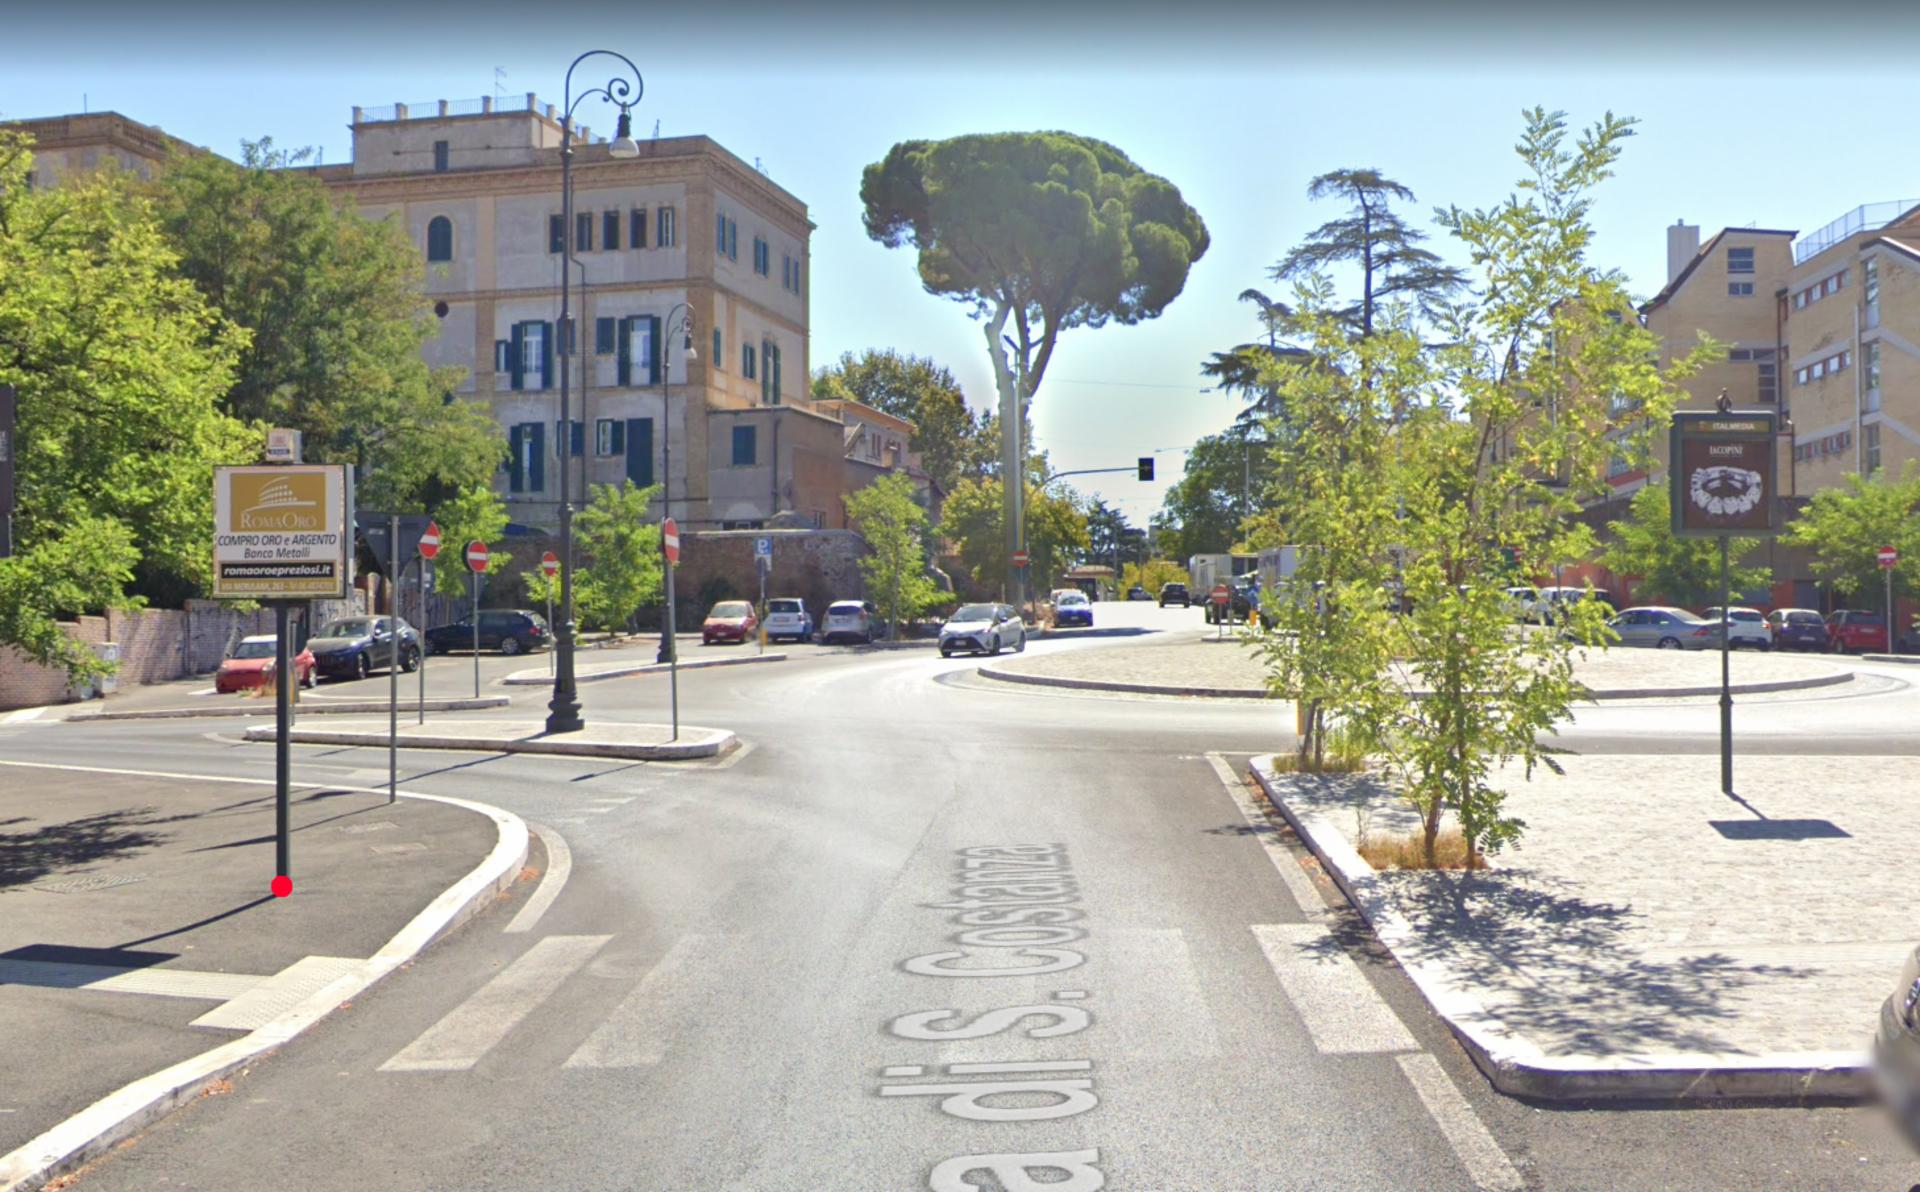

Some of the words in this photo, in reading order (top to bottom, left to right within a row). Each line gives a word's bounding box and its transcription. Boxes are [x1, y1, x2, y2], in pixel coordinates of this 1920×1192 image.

[218, 535, 259, 546] COMPRO
[261, 535, 282, 546] ORO
[284, 537, 290, 545] e
[292, 534, 336, 545] ARGENTO
[276, 547, 310, 558] Metalli
[757, 539, 769, 554] P
[224, 565, 331, 577] romaoroepreziosi.it
